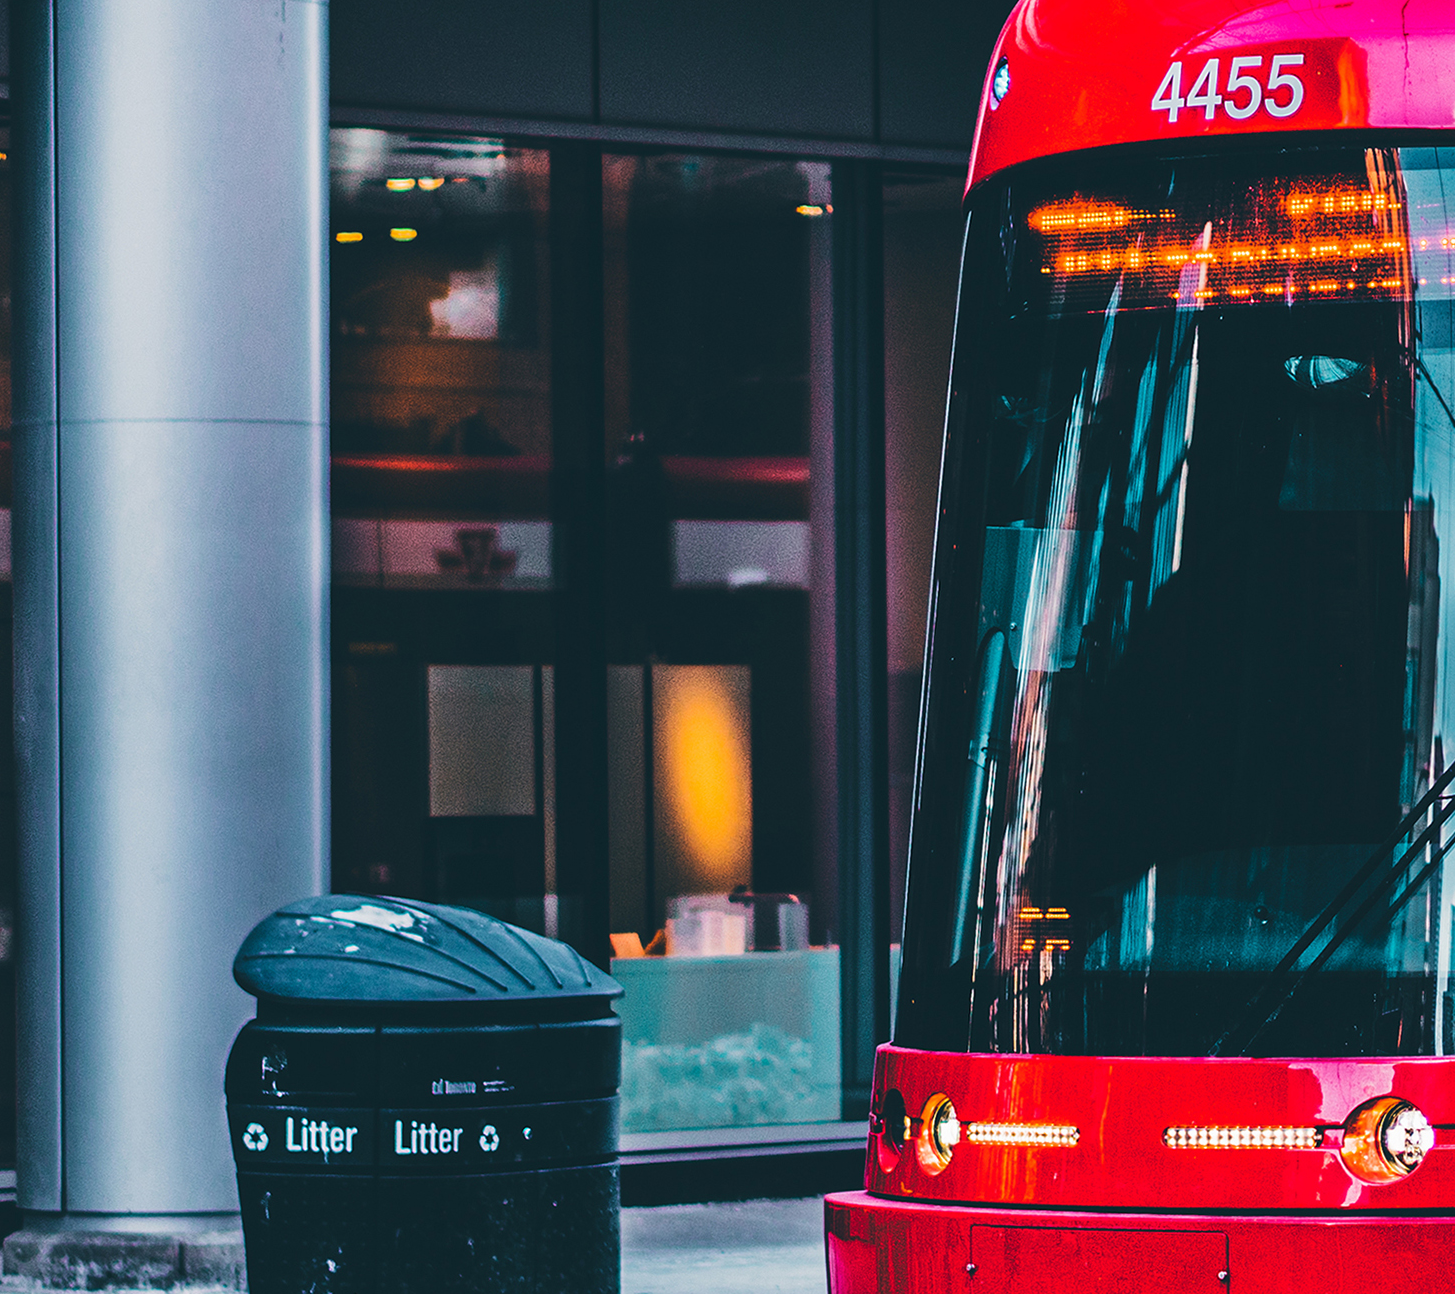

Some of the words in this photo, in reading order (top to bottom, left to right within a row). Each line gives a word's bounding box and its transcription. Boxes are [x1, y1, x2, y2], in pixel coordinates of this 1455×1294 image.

[1151, 53, 1305, 123] 4455
[285, 1117, 358, 1154] Litter
[394, 1120, 463, 1156] Litter
